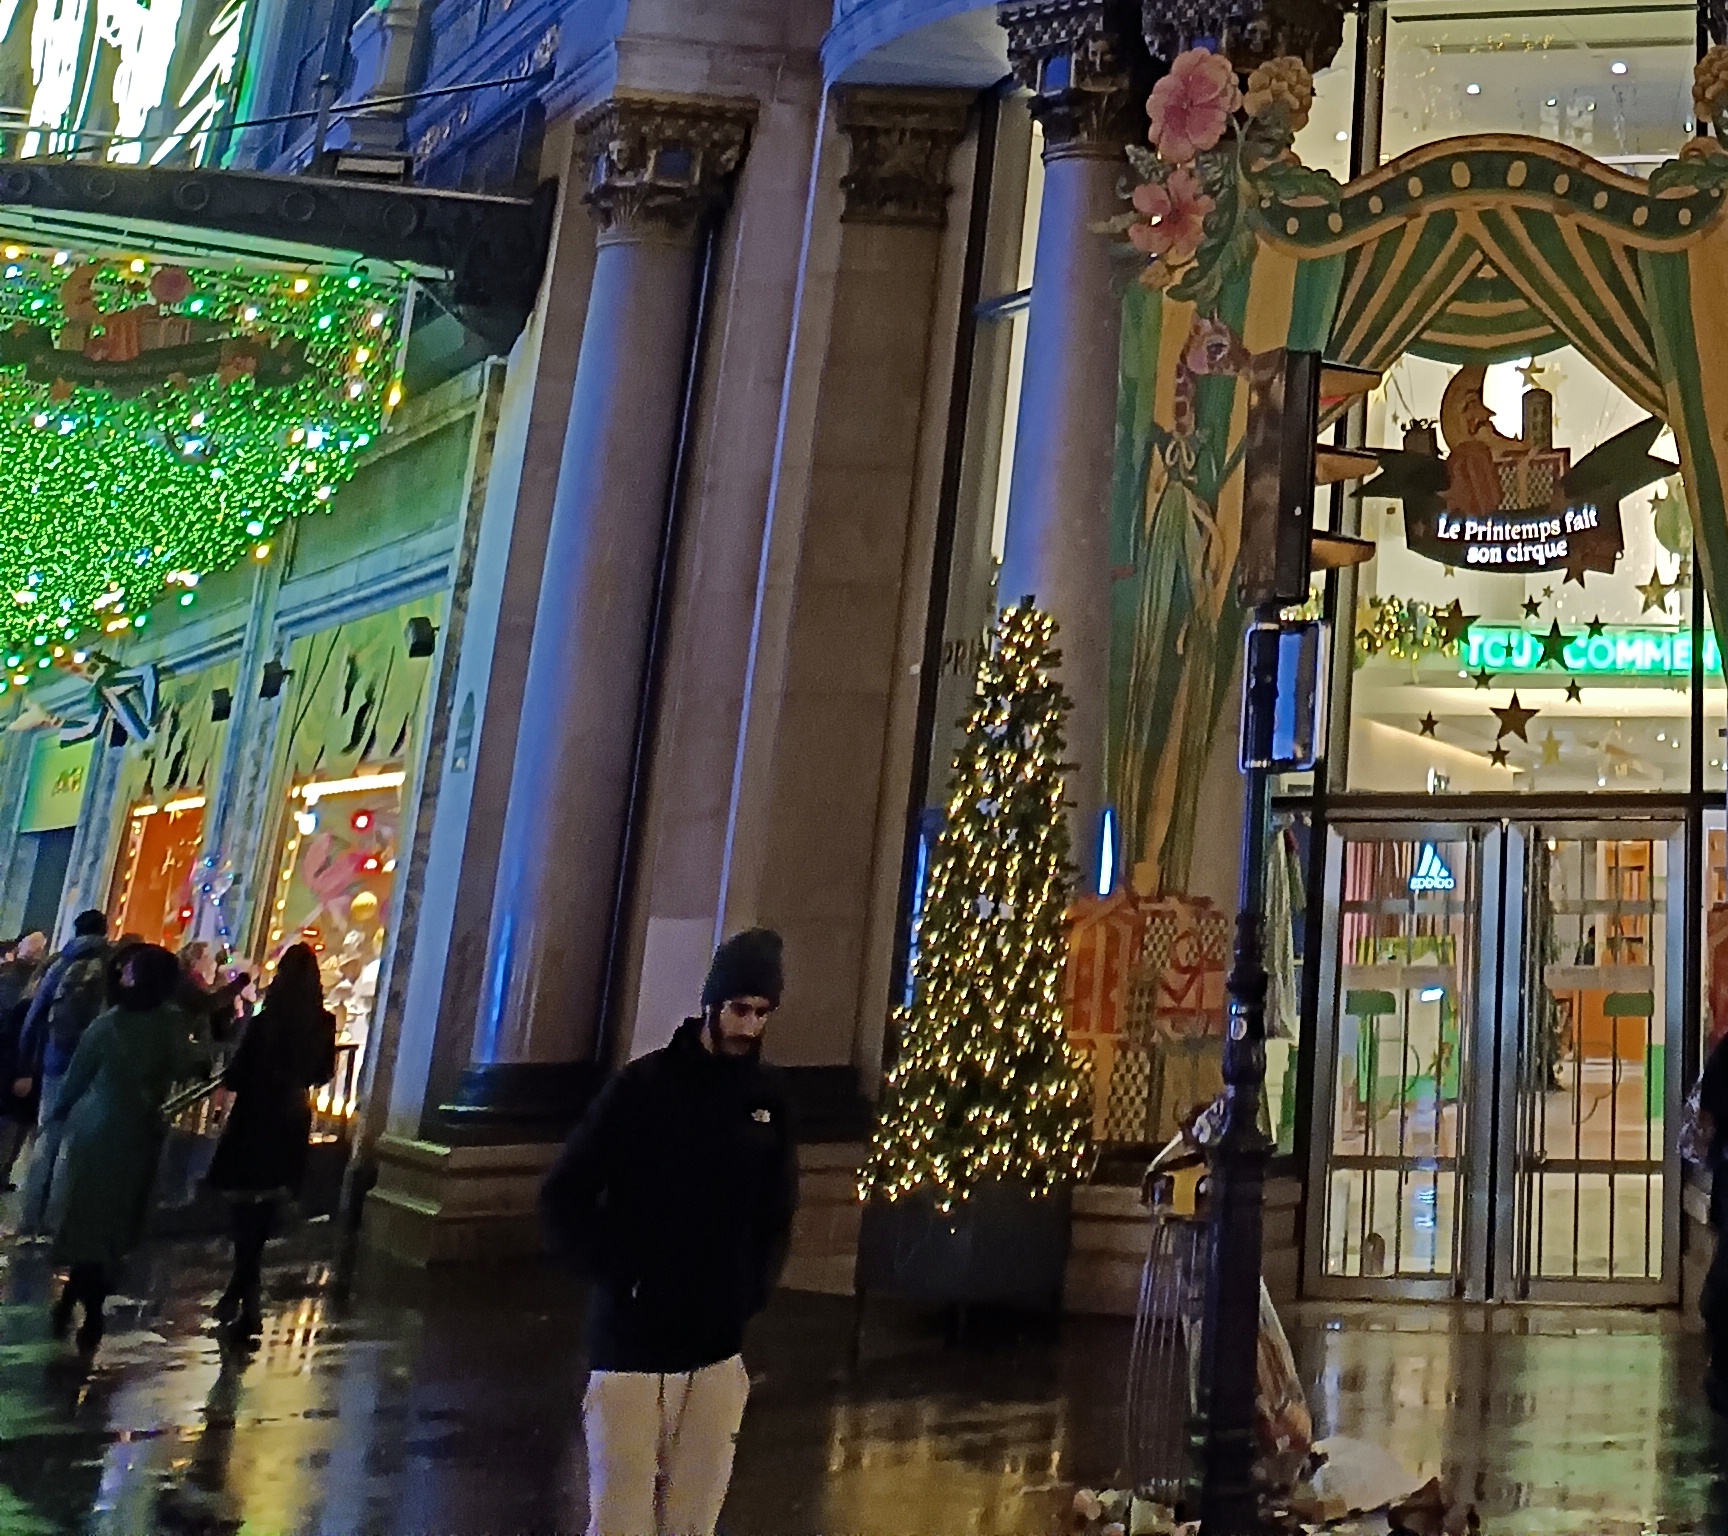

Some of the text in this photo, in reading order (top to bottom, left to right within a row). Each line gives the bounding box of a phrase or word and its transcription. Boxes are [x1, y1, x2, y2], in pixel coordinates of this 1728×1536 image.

[1437, 504, 1599, 543] Le Printemps fait
[1466, 540, 1568, 566] son cirque
[1467, 632, 1545, 668] TOU
